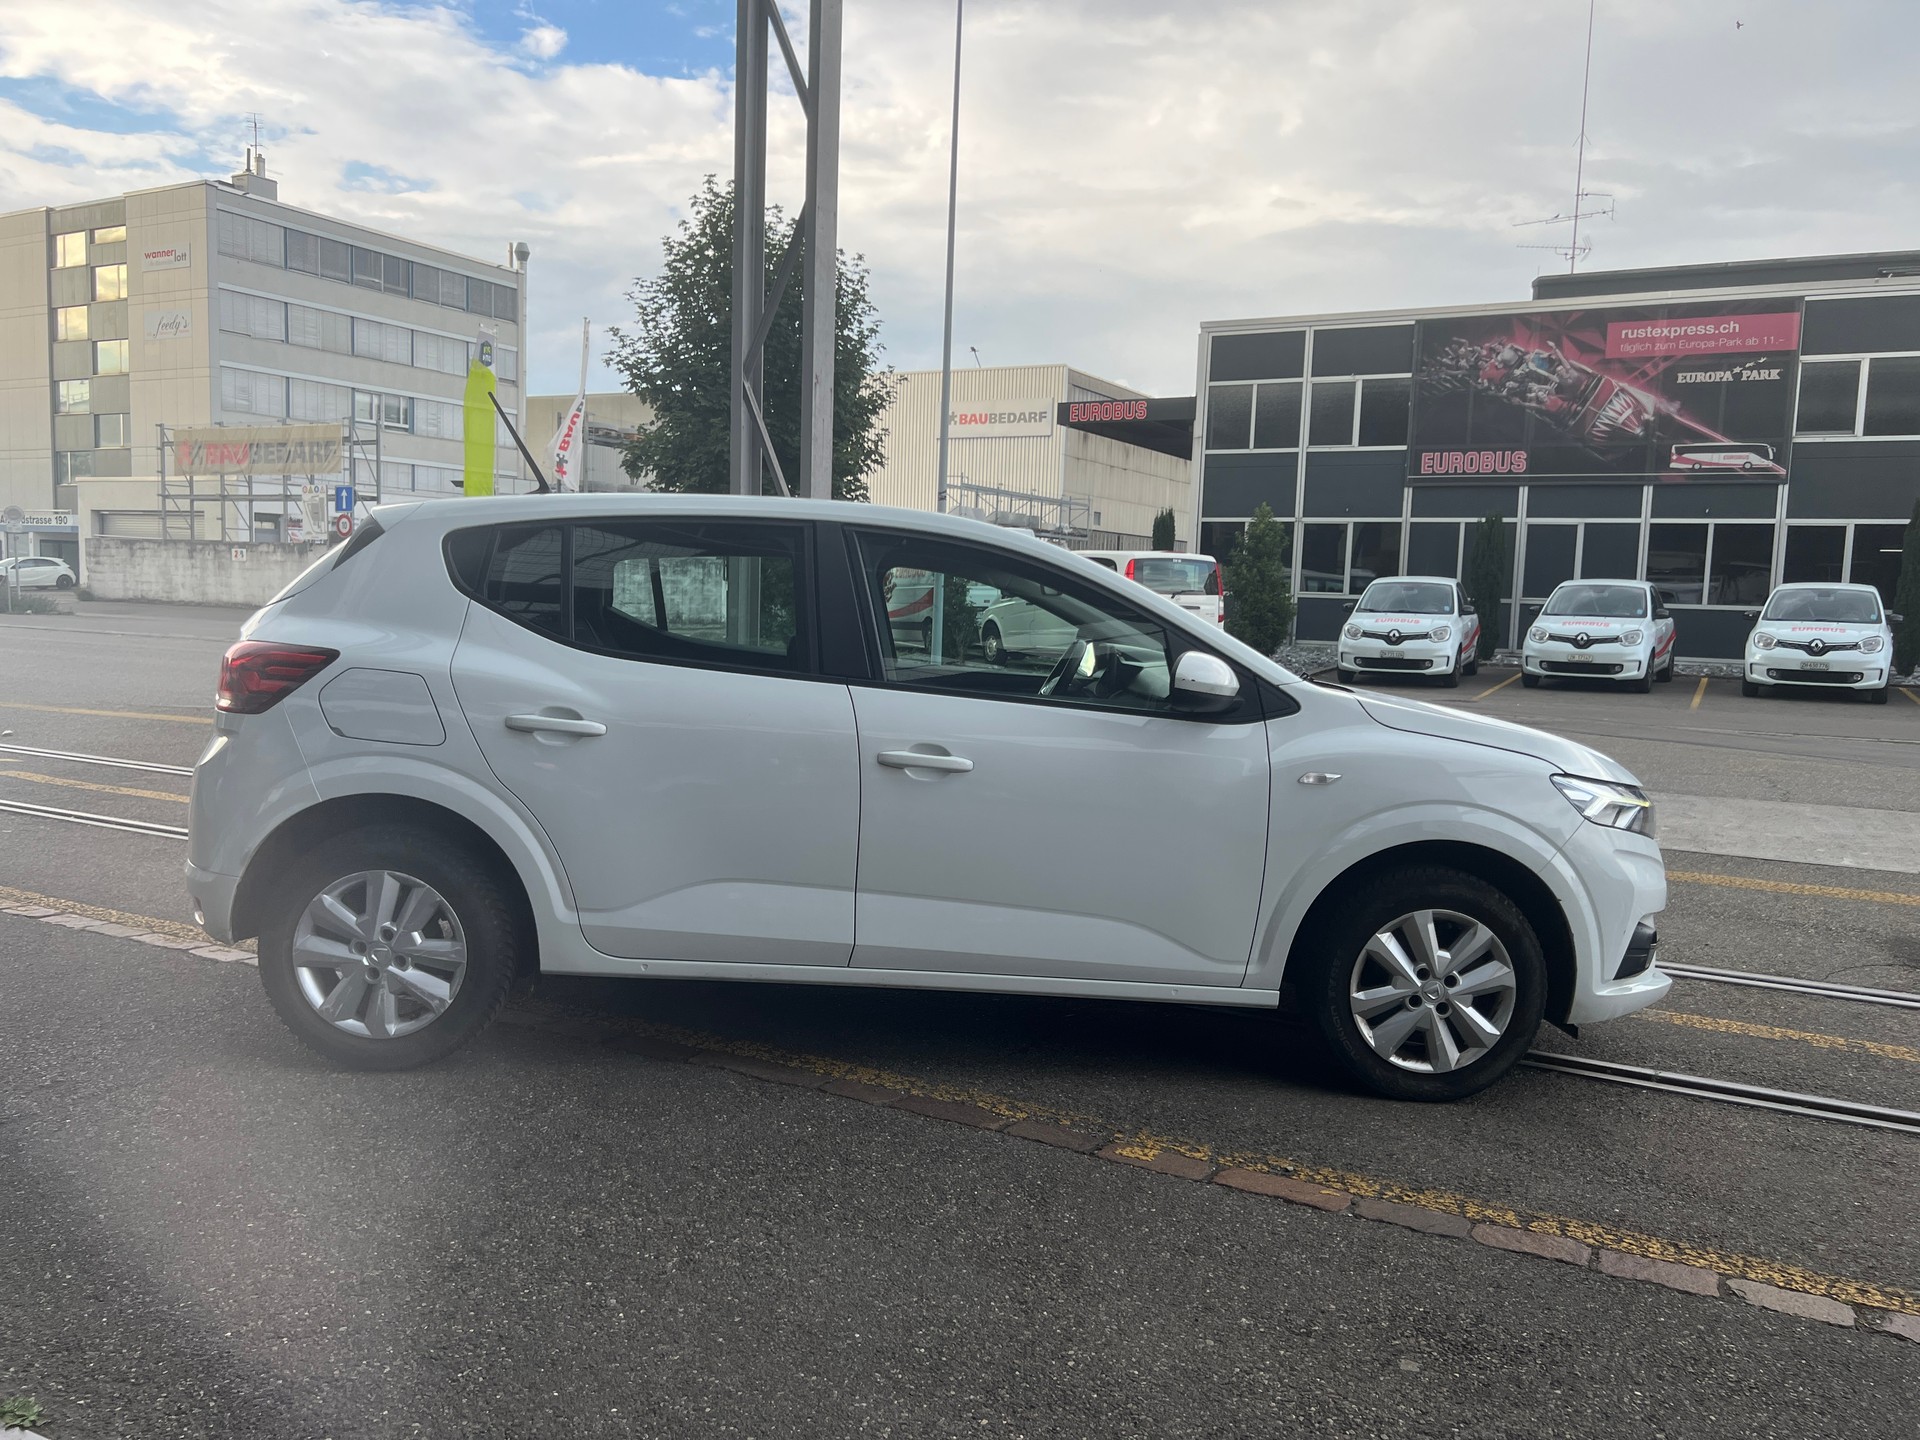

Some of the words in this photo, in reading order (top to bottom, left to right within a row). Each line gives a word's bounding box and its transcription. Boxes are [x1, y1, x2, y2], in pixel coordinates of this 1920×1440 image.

[144, 249, 174, 259] wanner
[1621, 320, 1740, 340] rustexpress.ch
[1620, 342, 1652, 354] täglich
[1654, 342, 1677, 350] zum
[1678, 337, 1742, 351] Europa-Park
[1745, 336, 1759, 346] ab
[1676, 370, 1734, 384] EUROPA
[1740, 368, 1781, 381] PARK
[958, 411, 1048, 425] BAUBEDARF
[1069, 400, 1148, 423] EUROBUS
[1420, 450, 1528, 474] EUROBUS
[54, 515, 68, 525] 190
[1374, 617, 1422, 625] EUROBUS
[1561, 620, 1611, 628] EUROBUS
